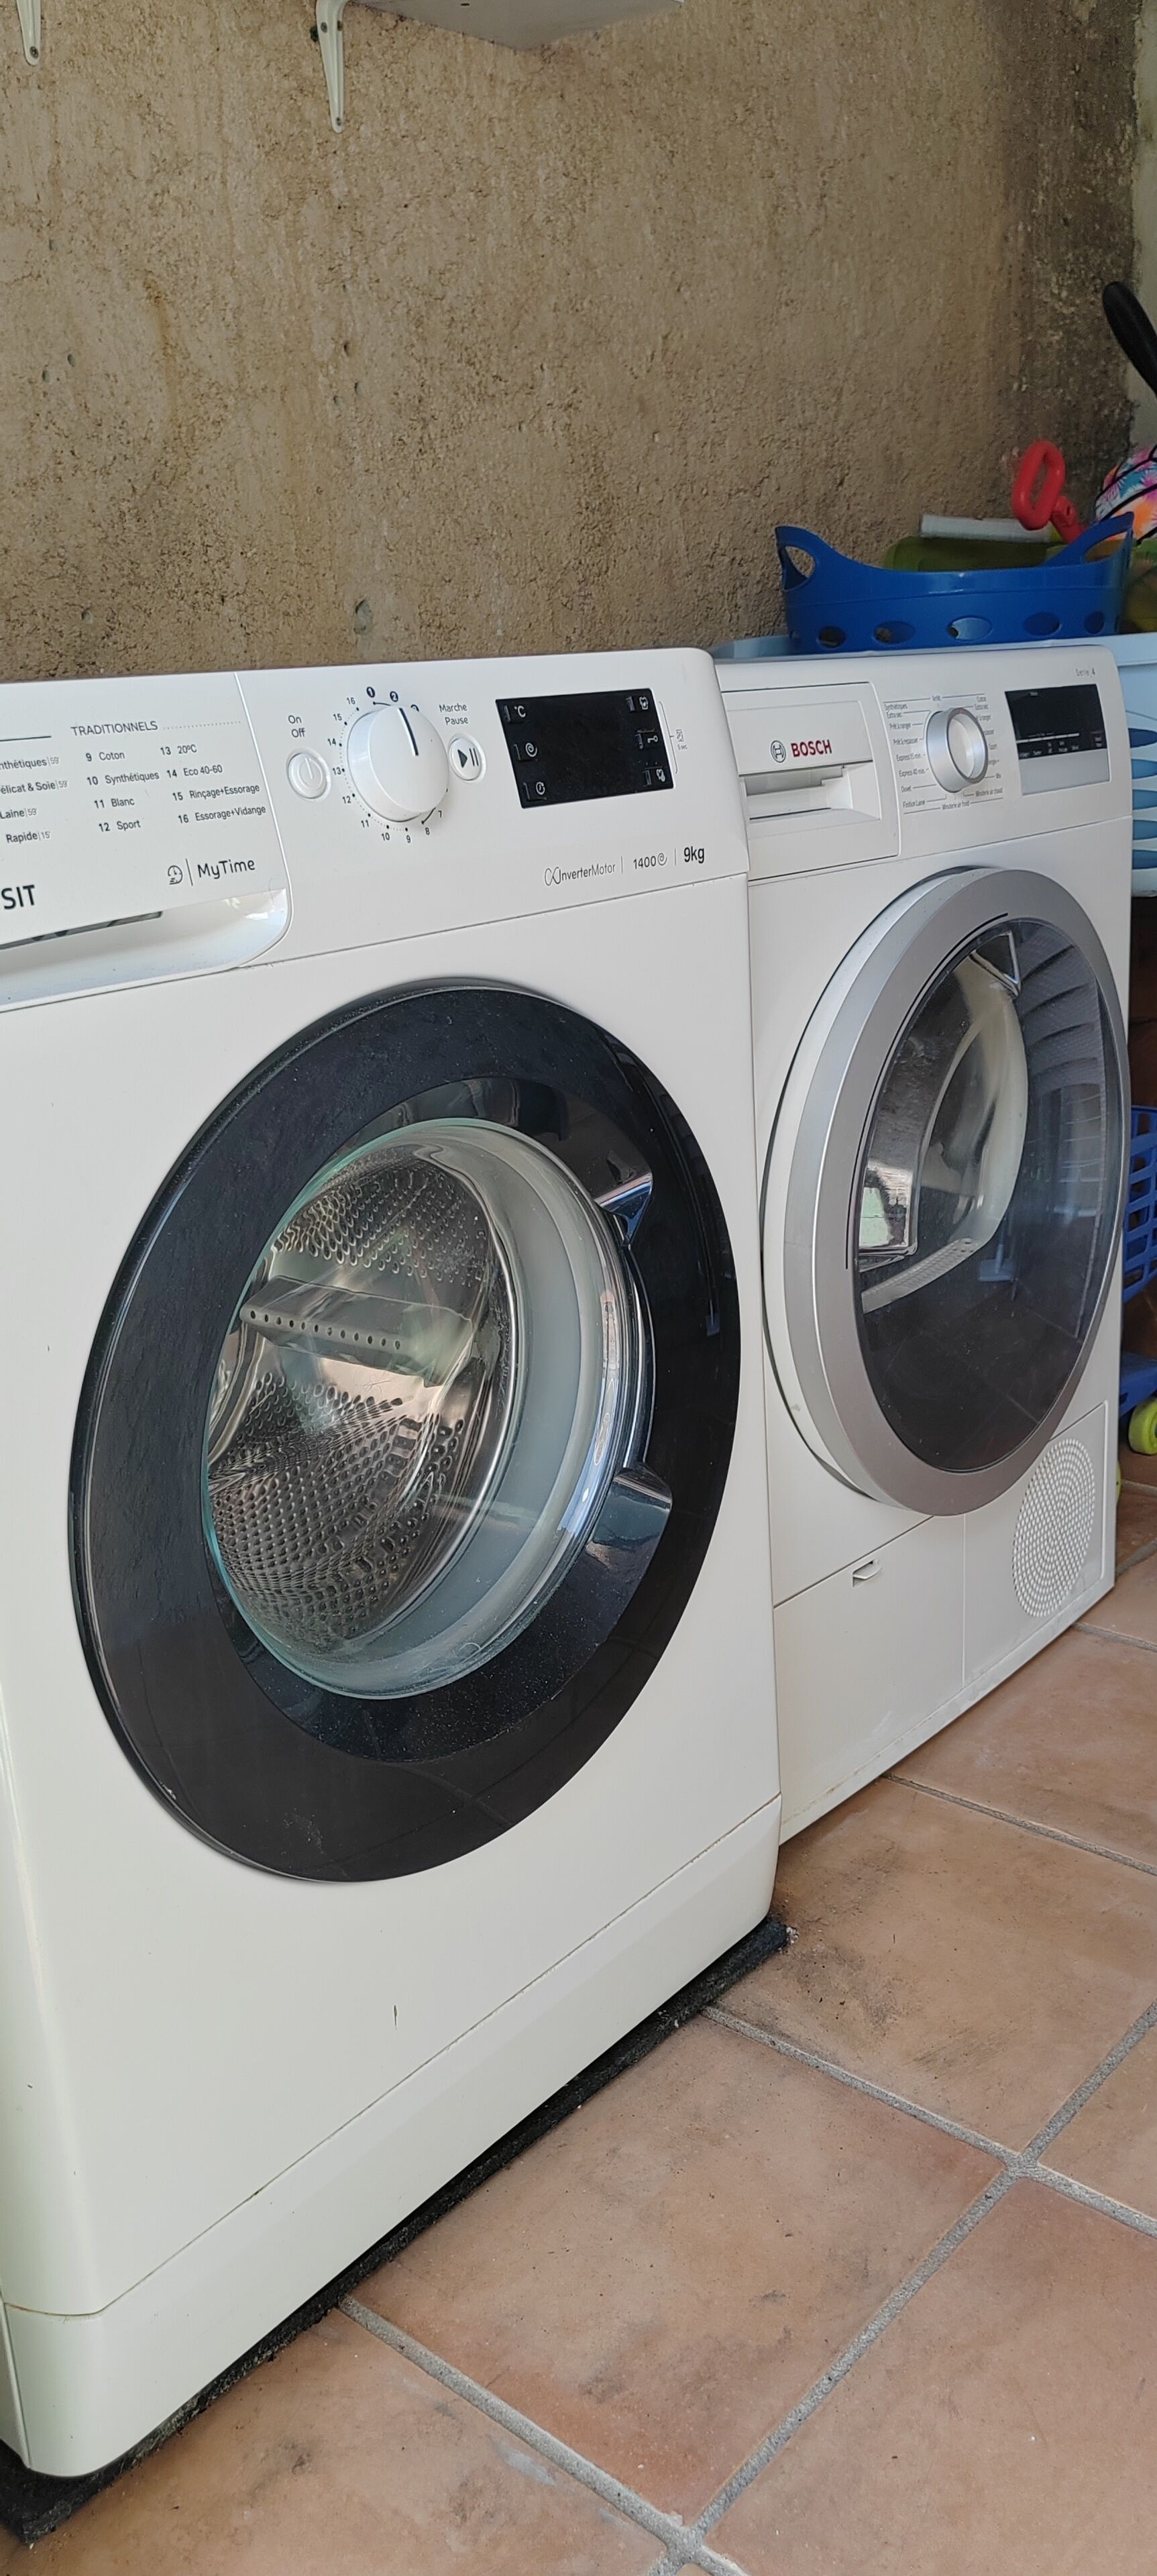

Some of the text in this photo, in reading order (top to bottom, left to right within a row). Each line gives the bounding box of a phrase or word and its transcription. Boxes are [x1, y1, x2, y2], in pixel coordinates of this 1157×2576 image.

[347, 697, 355, 705] 16
[439, 703, 467, 713] Marche
[288, 714, 302, 724] On
[333, 713, 342, 721] 15
[445, 716, 469, 726] Pause
[70, 720, 158, 736] TRADITIONNELS
[291, 728, 306, 739] Off
[327, 738, 336, 746] 14
[160, 746, 172, 755] 13
[791, 739, 832, 757] BOSCH
[86, 752, 125, 761] 9 Coton
[166, 764, 223, 778] 14 Eco 40-60
[333, 767, 341, 775] 13
[87, 772, 160, 786] 10 Synthétiques
[27, 783, 34, 792] &
[35, 782, 56, 791] Soie
[172, 784, 260, 801] 15 Rinçage+Essorage
[95, 798, 135, 809] 11 Blanc
[342, 796, 351, 804] 12
[0, 809, 25, 819] Laine
[178, 806, 266, 824] 16 Essorage+Vidange
[99, 820, 141, 833] 12 Sport
[361, 820, 370, 828] 11
[425, 827, 430, 835] 8
[6, 831, 38, 844] Rapide
[381, 833, 390, 841] 10
[406, 835, 411, 843] 9
[633, 856, 657, 869] 1400
[684, 846, 704, 864] 9kg
[197, 859, 256, 879] MyTime
[1, 884, 36, 910] SIT
